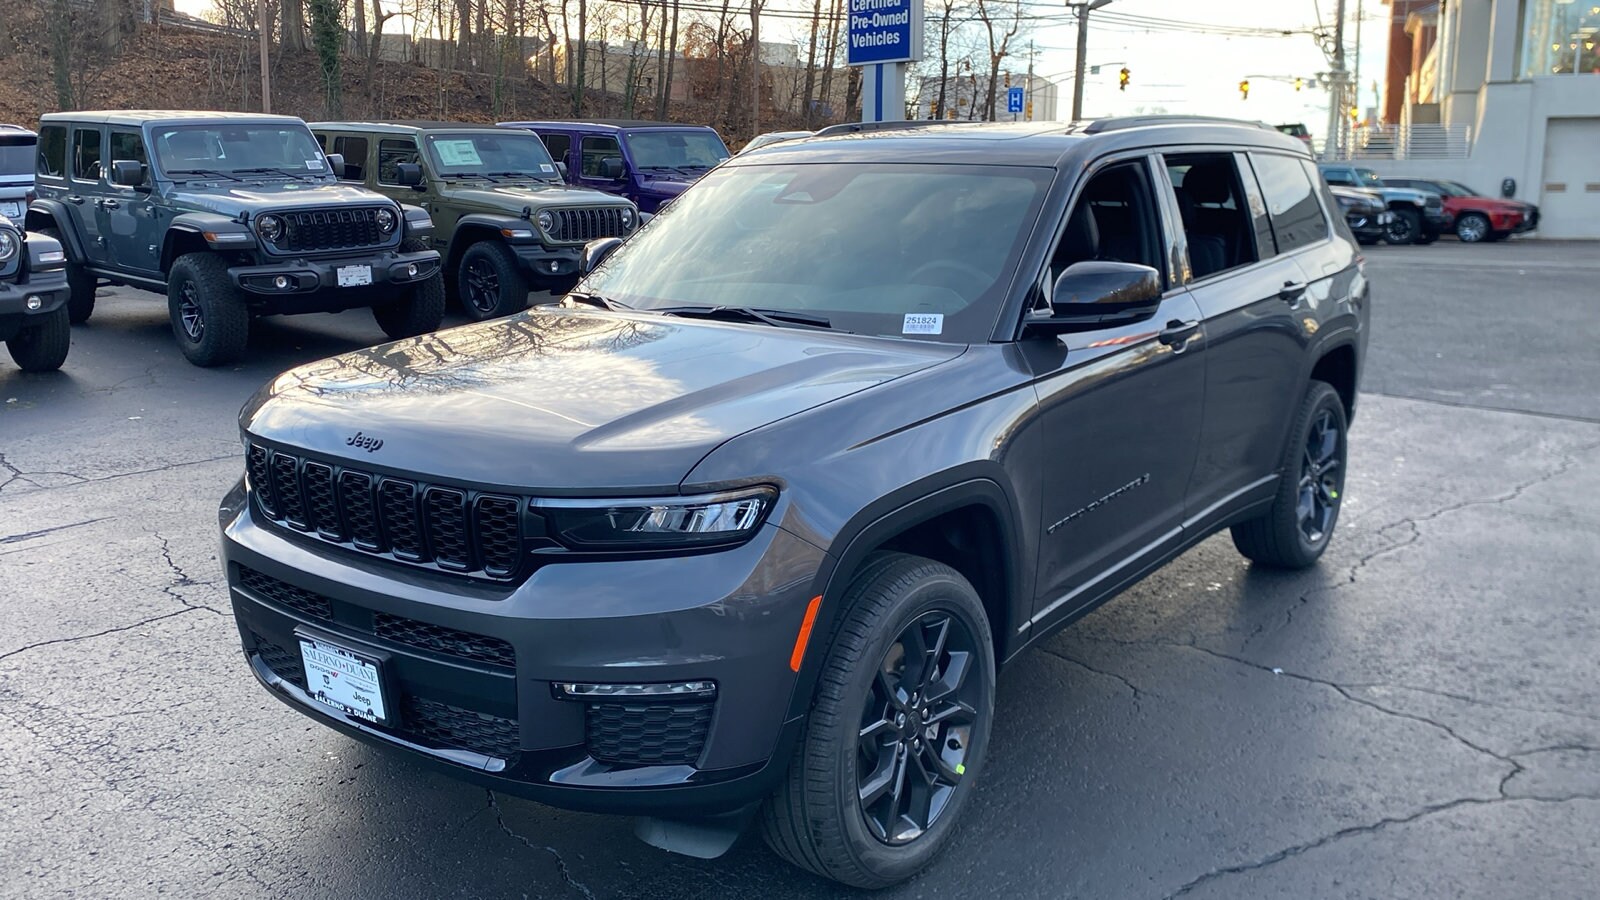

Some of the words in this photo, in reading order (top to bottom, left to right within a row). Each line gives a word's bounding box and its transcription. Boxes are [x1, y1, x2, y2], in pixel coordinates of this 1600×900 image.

[851, 9, 908, 30] Pre-Owned
[851, 30, 900, 48] Vehicles
[1011, 93, 1020, 106] H
[346, 431, 384, 453] Jeep
[303, 647, 341, 669] SALERNO
[345, 661, 378, 683] DUANE
[353, 691, 371, 706] Jeep
